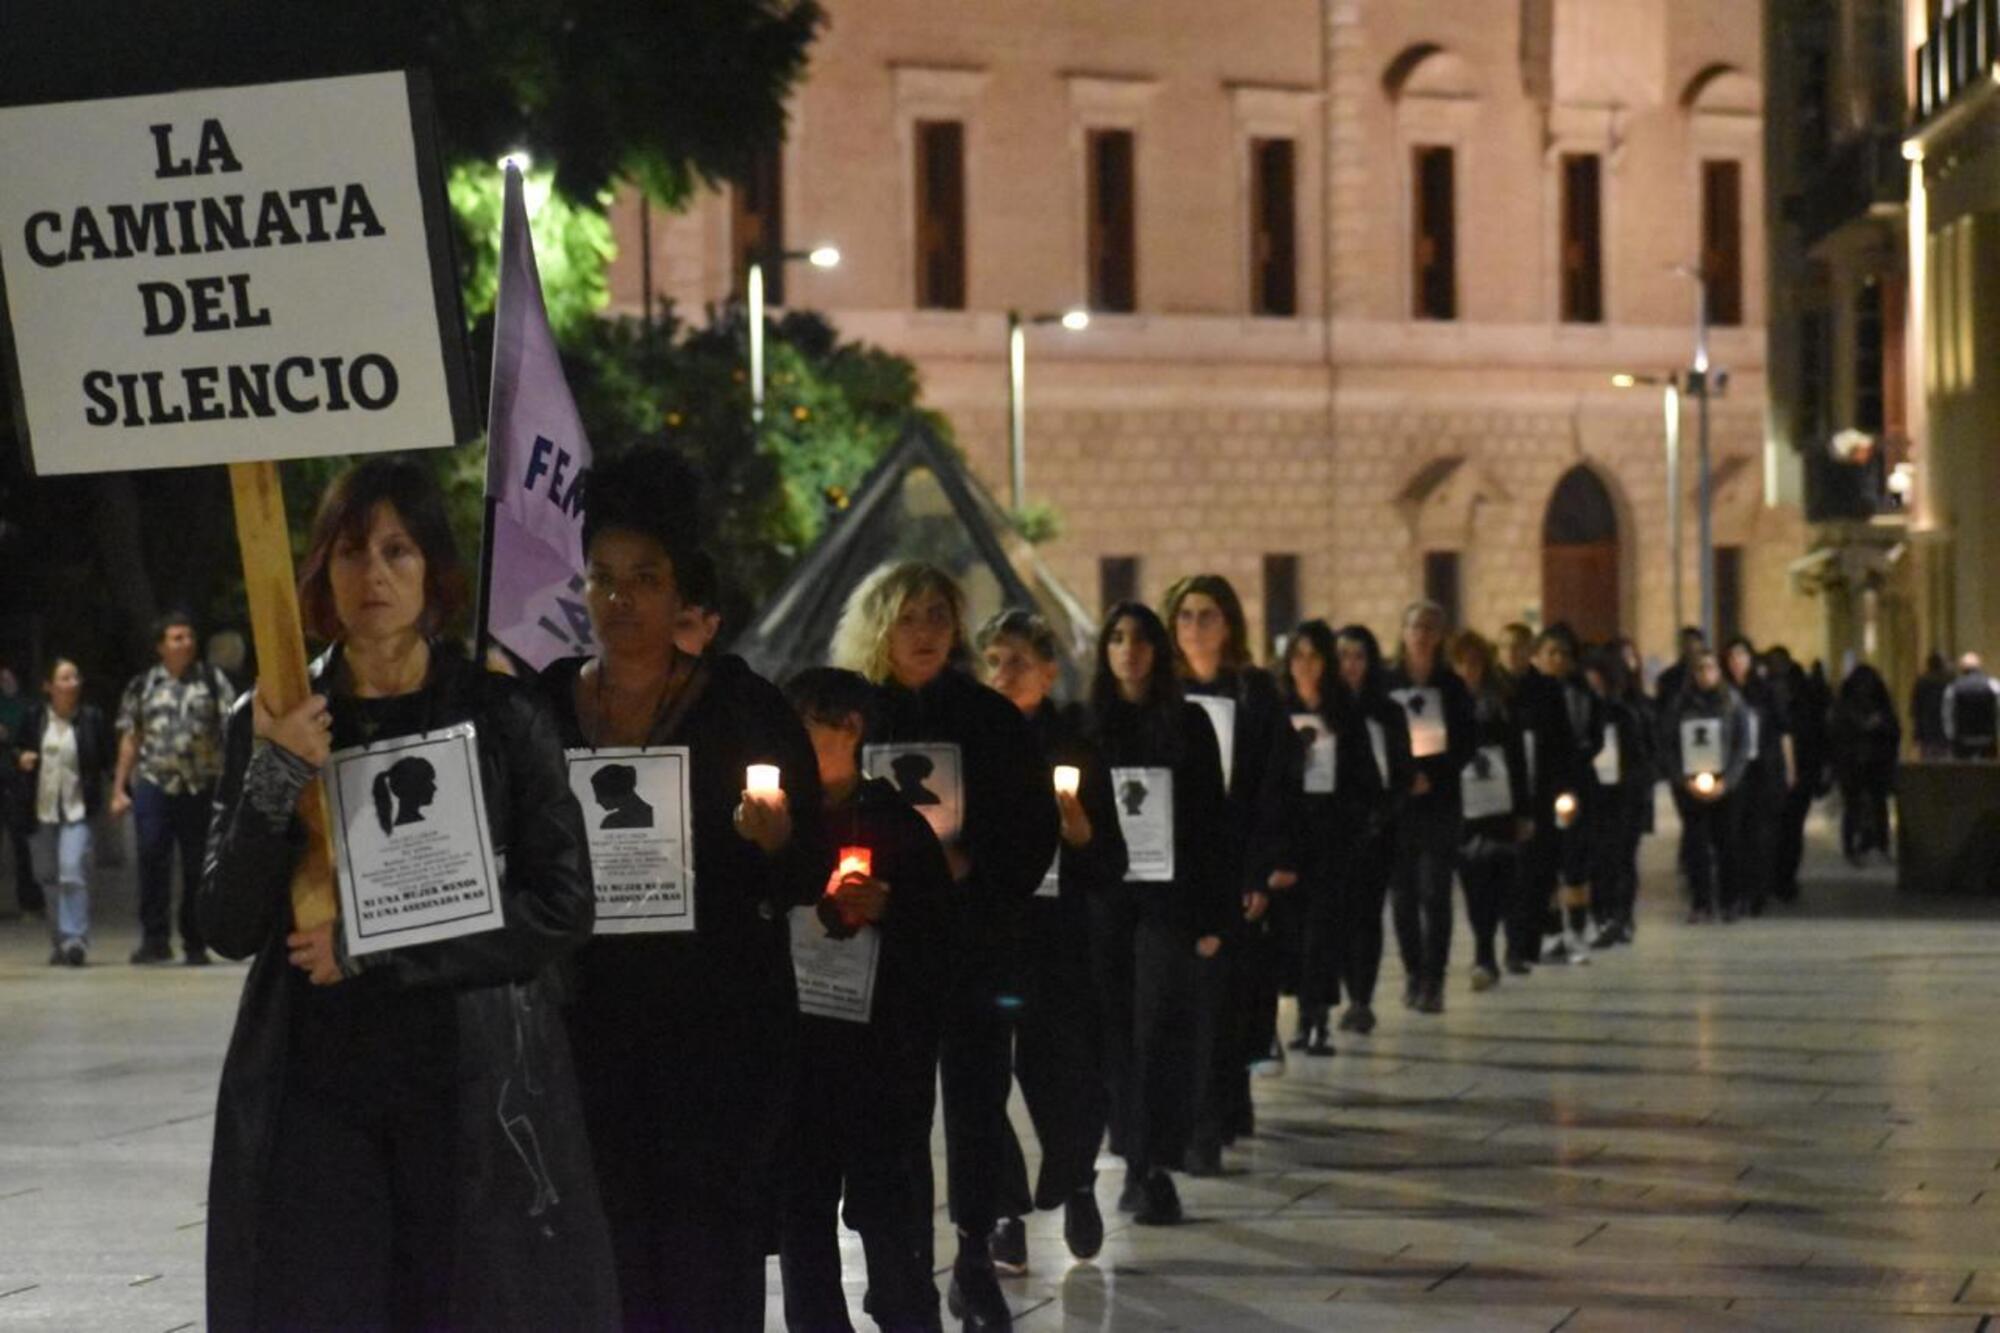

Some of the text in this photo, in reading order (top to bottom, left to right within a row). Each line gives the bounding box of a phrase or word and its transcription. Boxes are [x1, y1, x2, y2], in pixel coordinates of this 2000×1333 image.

[150, 119, 243, 179] LA
[24, 183, 386, 268] CAMINATA
[138, 274, 272, 337] DEL
[83, 353, 400, 428] SILENCIO
